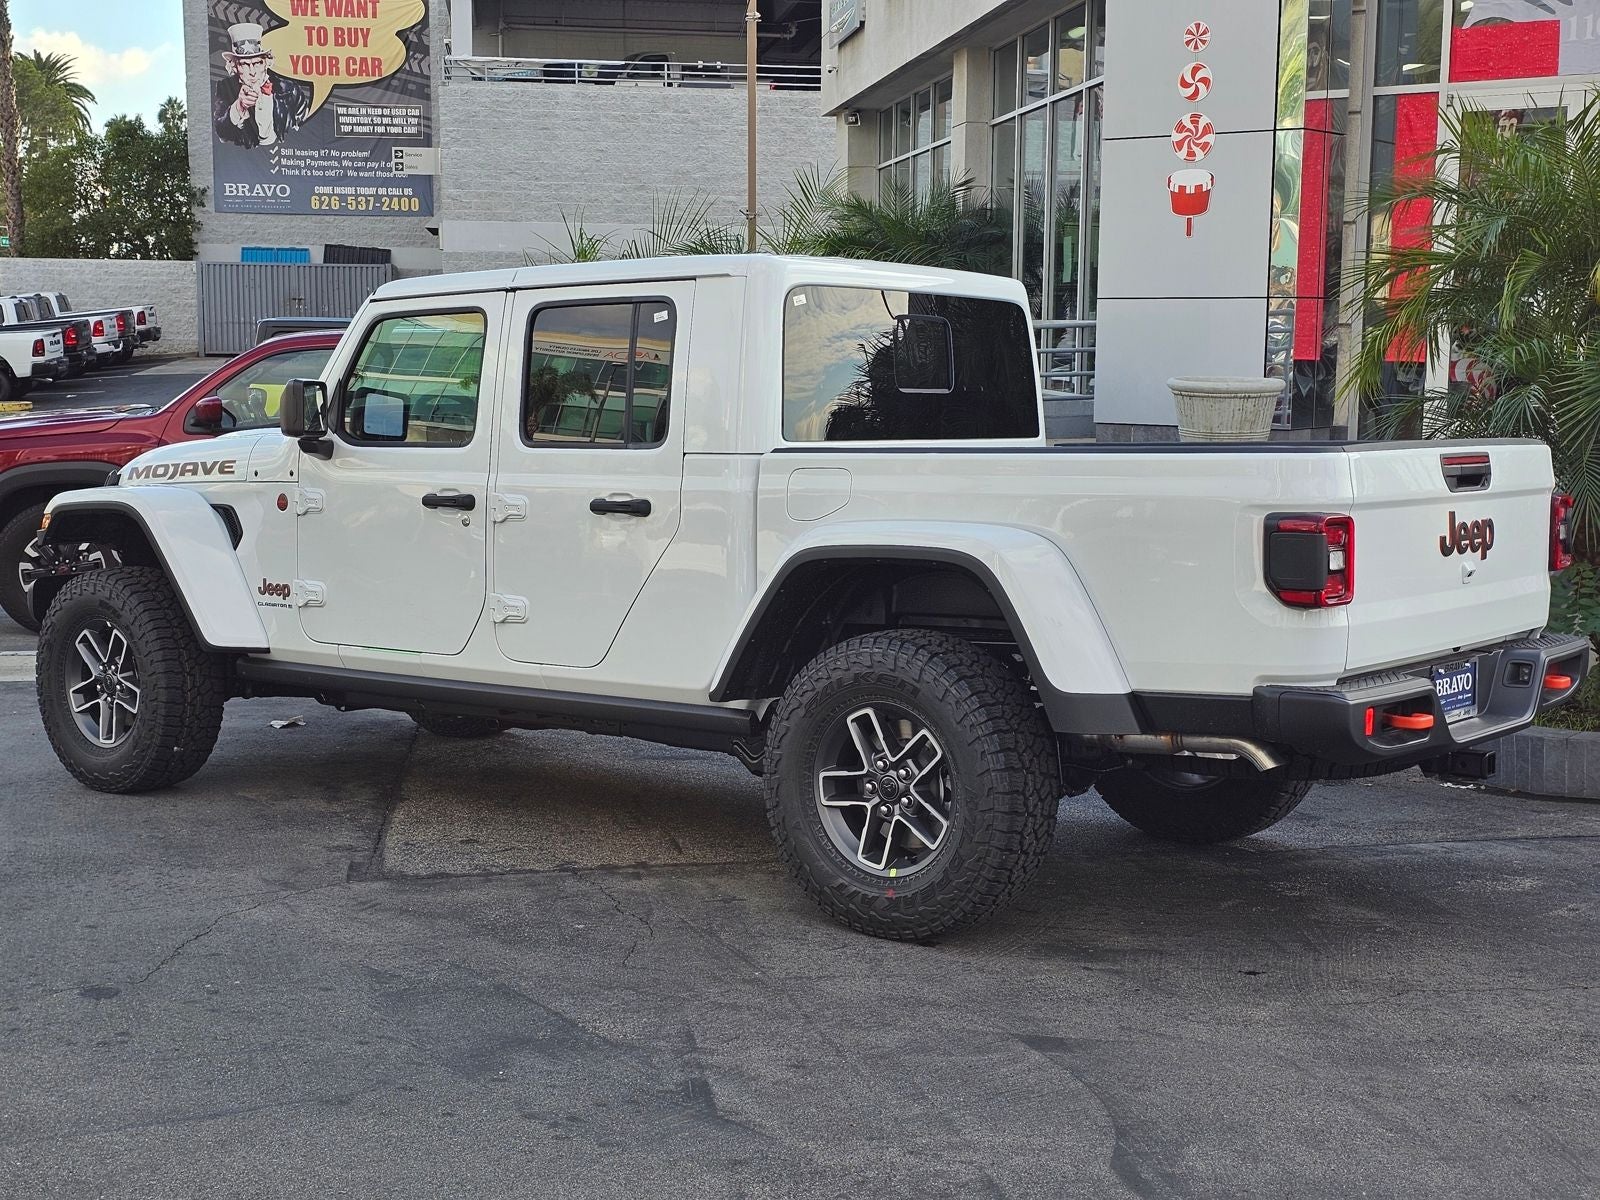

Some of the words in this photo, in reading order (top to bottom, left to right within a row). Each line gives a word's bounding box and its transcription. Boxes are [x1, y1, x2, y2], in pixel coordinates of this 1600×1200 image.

[290, 0, 319, 16] WE
[324, 0, 379, 18] WANT
[304, 26, 328, 46] TO
[333, 27, 371, 47] BUY
[289, 55, 340, 76] YOUR
[345, 56, 383, 77] CAR
[347, 107, 359, 115] ARE
[391, 108, 407, 116] USED
[392, 117, 407, 125] WILL
[403, 126, 418, 134] CAR!
[295, 148, 318, 157] leasing
[341, 150, 371, 158] problem!
[281, 158, 305, 167] Making
[366, 161, 380, 169] pay
[281, 167, 300, 175] Think
[223, 183, 291, 197] BRAVO
[314, 185, 333, 194] COME
[334, 186, 356, 194] INSIDE
[356, 186, 377, 195] TODAY
[377, 187, 387, 195] OR
[387, 187, 403, 195] CALL
[404, 188, 413, 196] US
[311, 195, 420, 212] 626-537-2400
[127, 460, 237, 480] MOJAVE
[1439, 510, 1495, 561] Jeep
[258, 577, 291, 600] Jeep
[1436, 672, 1472, 697] BRAVO
